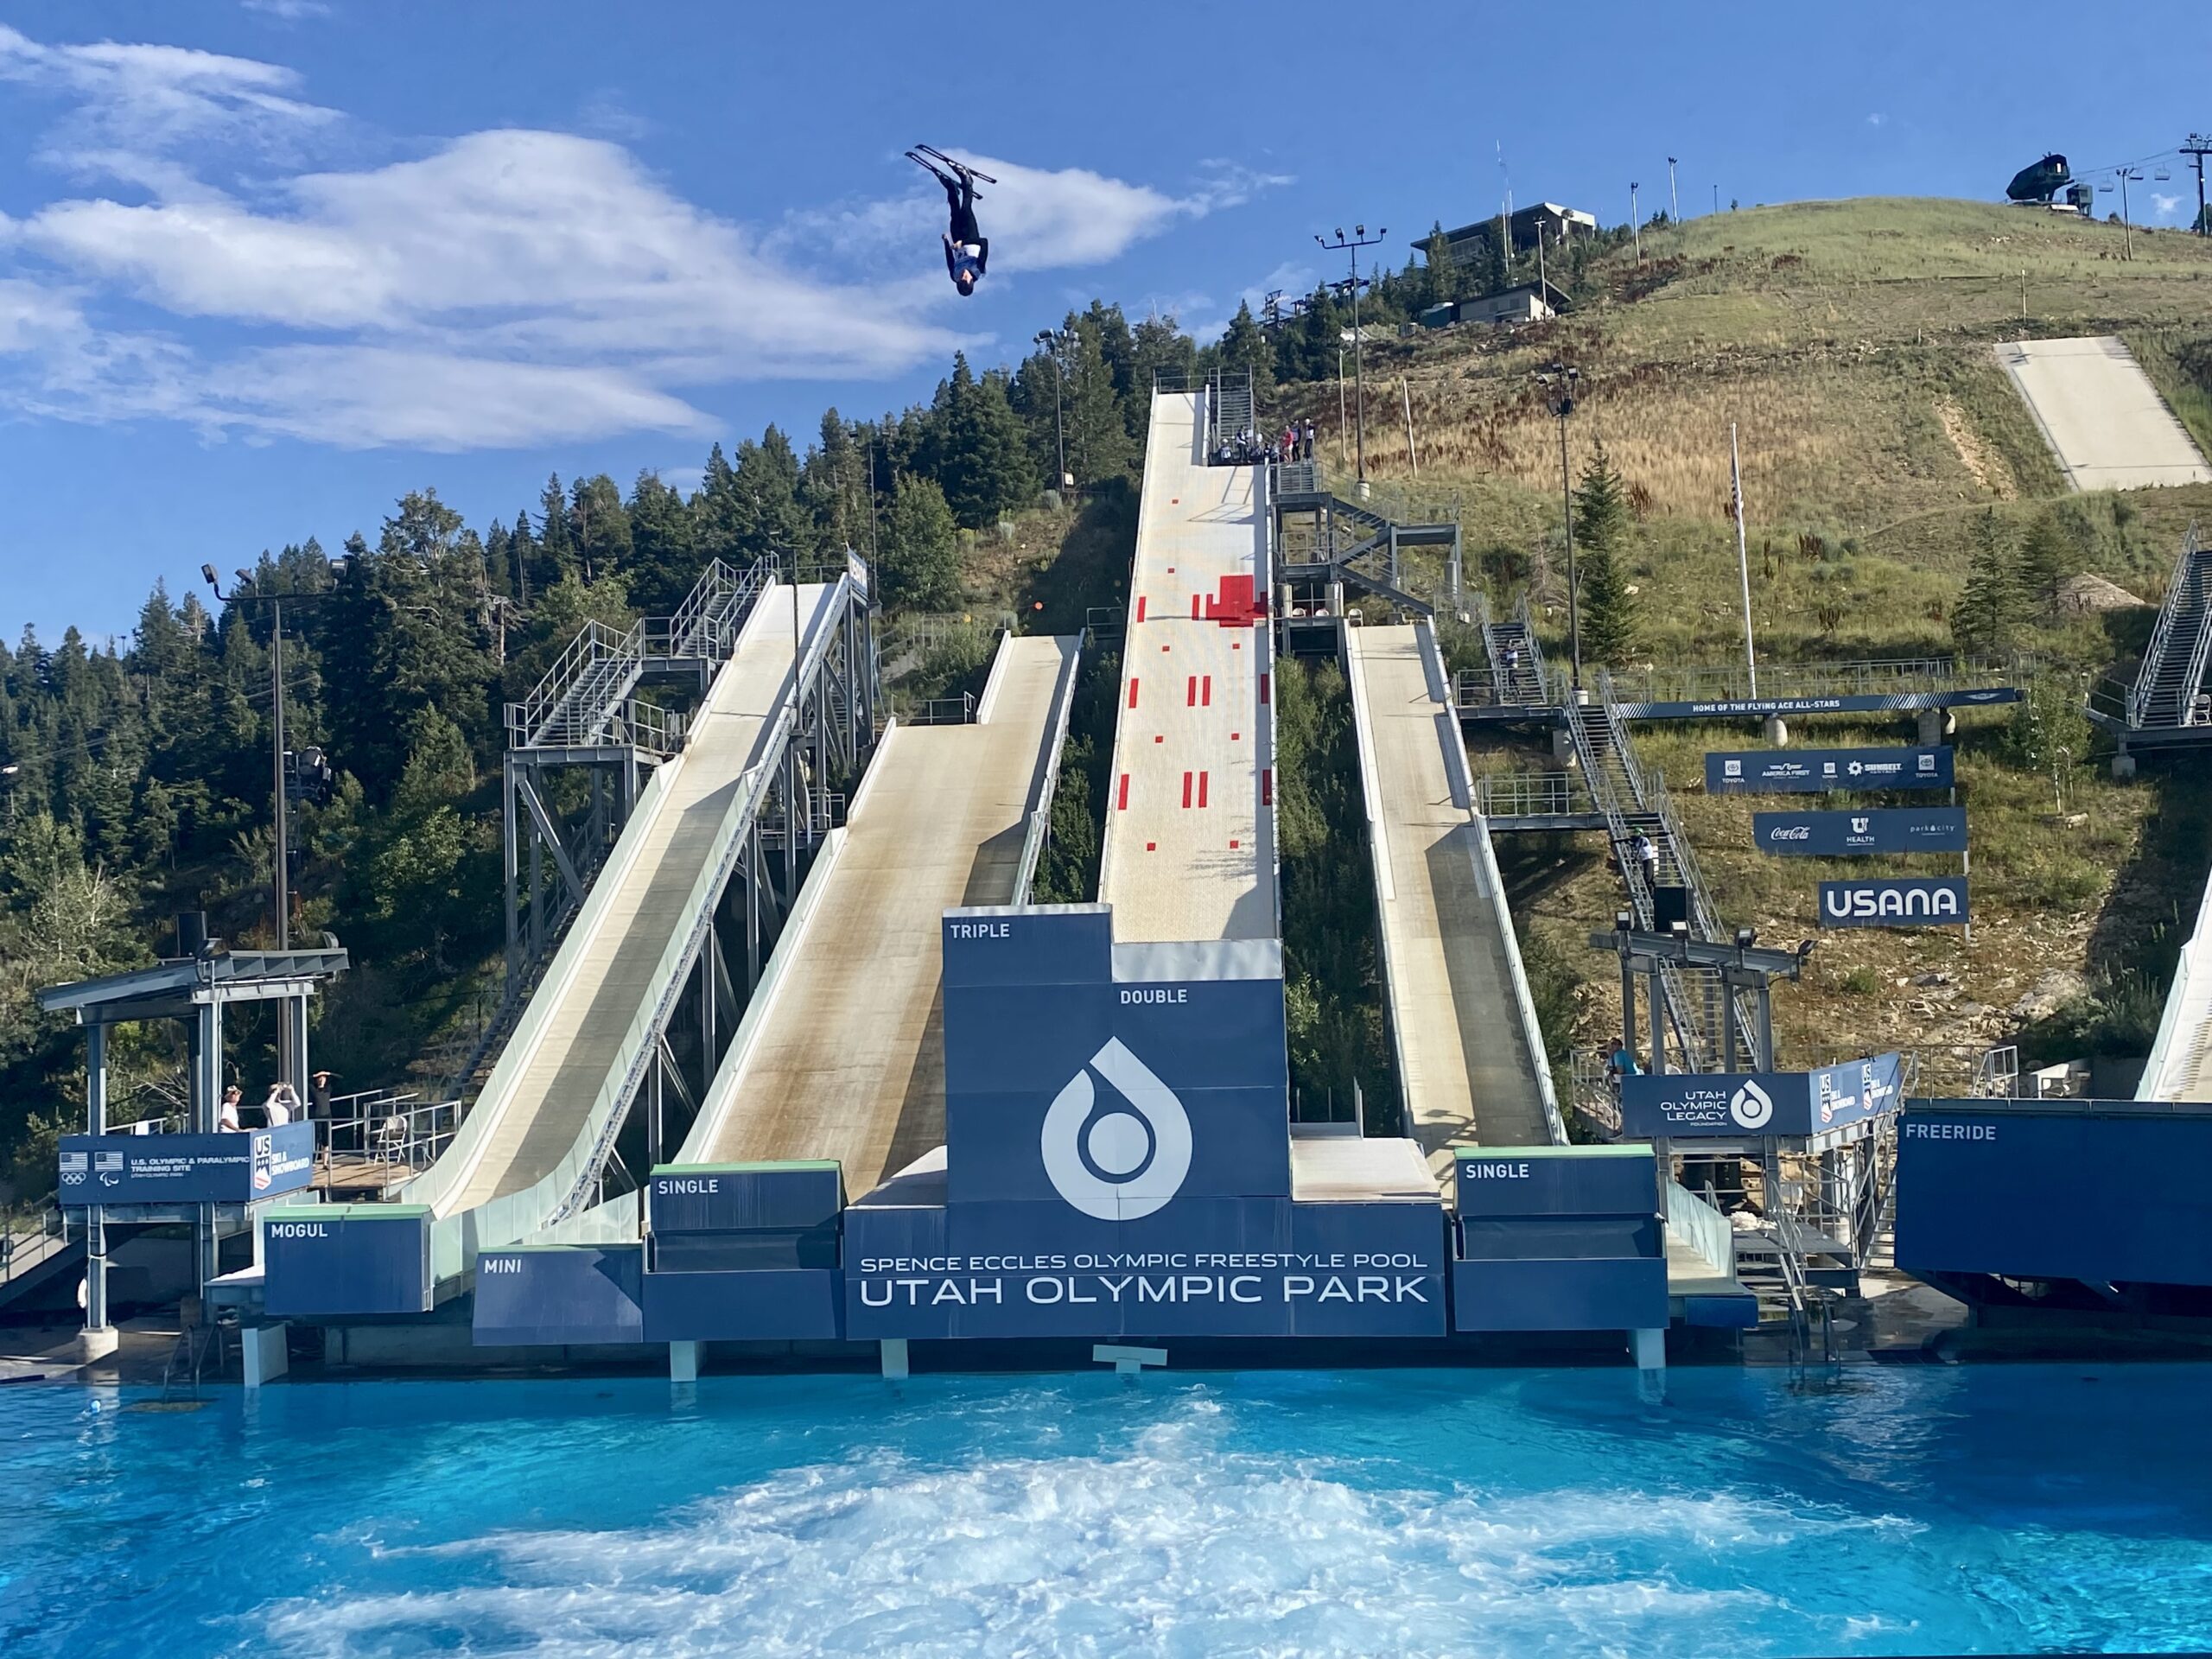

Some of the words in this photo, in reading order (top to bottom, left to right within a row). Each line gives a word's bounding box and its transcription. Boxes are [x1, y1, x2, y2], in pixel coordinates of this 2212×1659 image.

[1730, 702, 1745, 711] THE
[1747, 702, 1776, 710] FLYING
[1795, 700, 1840, 709] ALL-STARS
[1827, 887, 1957, 918] USANA
[950, 923, 1010, 938] TRIPLE
[1120, 988, 1188, 1005] DOUBLE
[1685, 1090, 1726, 1100] UTAH
[1660, 1101, 1726, 1110] OLYMPIC
[1667, 1111, 1726, 1121] LEGACY
[1906, 1123, 1997, 1140] FREERIDE
[256, 1137, 270, 1155] US
[1466, 1164, 1529, 1179] SINGLE
[658, 1179, 719, 1195] SINGLE
[270, 1224, 328, 1238] MOGUL
[484, 1258, 522, 1274] MINI
[861, 1257, 962, 1273] SPENCE
[969, 1255, 1066, 1270] ECCLES
[1073, 1253, 1187, 1268] OLYMPIC
[1195, 1253, 1345, 1268] FREESTYLE
[1353, 1253, 1428, 1268] POOL
[861, 1277, 1003, 1307] UTAH
[1026, 1275, 1262, 1304] OLYMPIC
[1283, 1275, 1429, 1303] PARK
